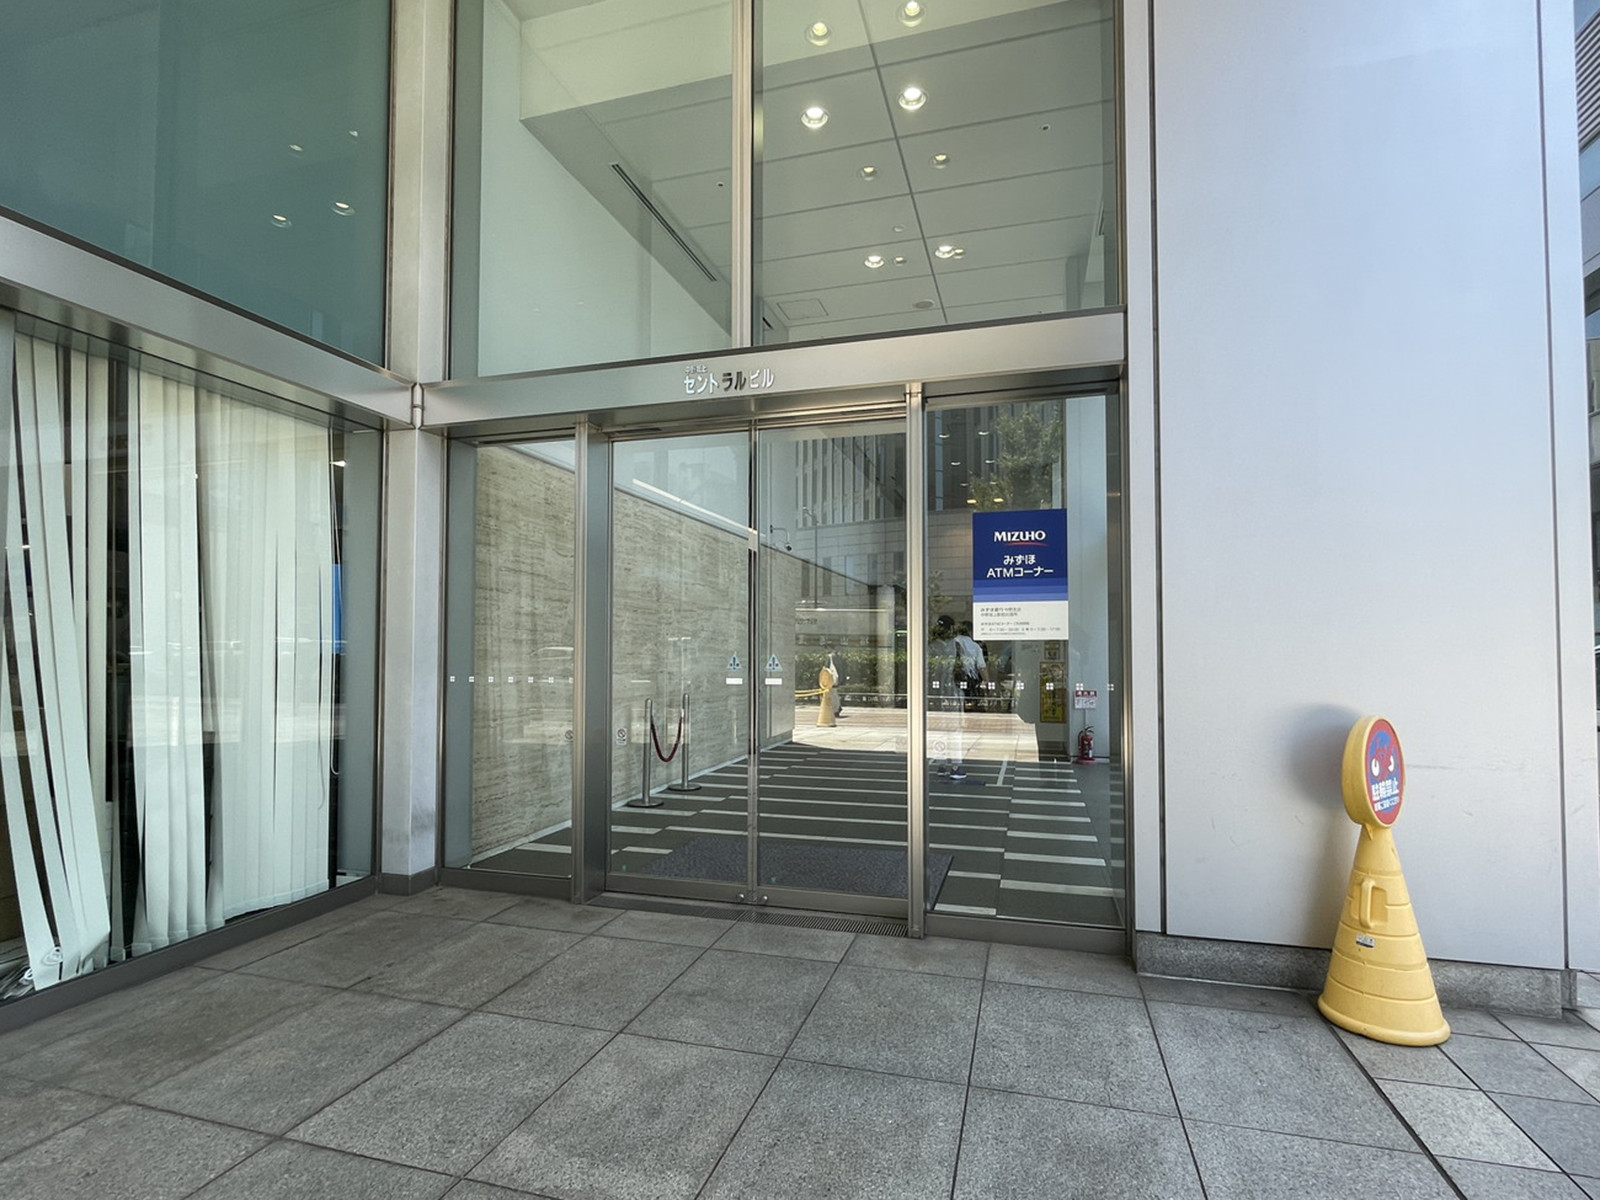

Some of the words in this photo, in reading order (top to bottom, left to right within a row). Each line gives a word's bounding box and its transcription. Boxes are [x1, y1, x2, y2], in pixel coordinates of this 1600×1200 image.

[684, 368, 774, 394] セントラルビル
[993, 530, 1046, 542] MIZUHO
[1003, 554, 1036, 565] みずほ
[986, 566, 1054, 578] ATMコーナー
